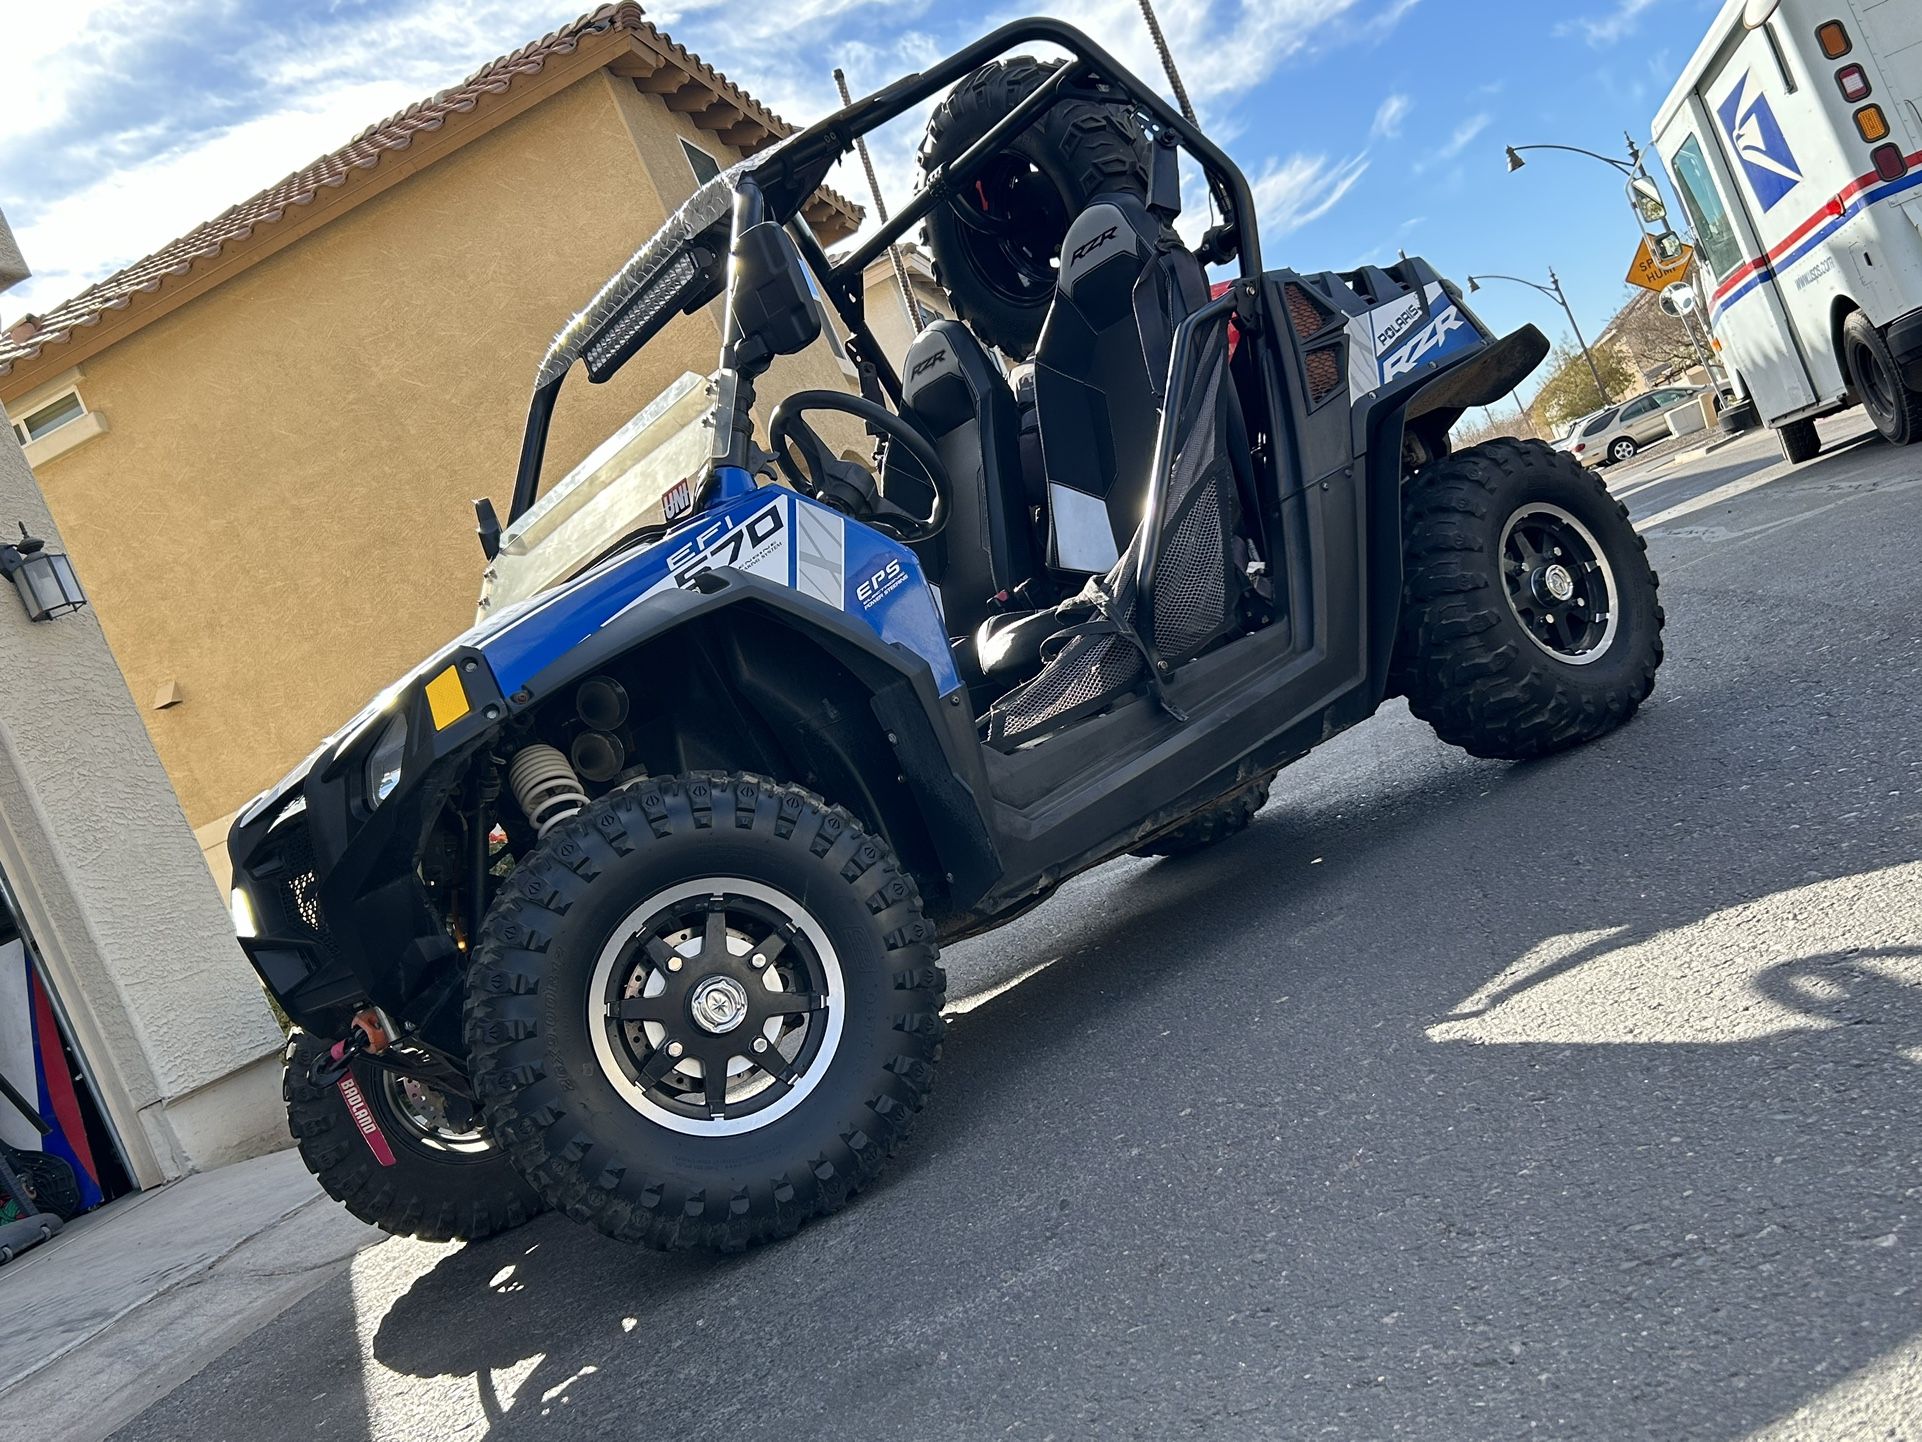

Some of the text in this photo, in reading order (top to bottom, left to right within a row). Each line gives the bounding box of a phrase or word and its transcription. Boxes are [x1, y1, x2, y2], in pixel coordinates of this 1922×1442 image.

[1071, 226, 1118, 267] RZR
[1377, 304, 1419, 346] POLARIS
[1383, 304, 1464, 385] RZR
[910, 350, 946, 382] RZR
[666, 515, 733, 571] EFI
[673, 505, 785, 595] 570
[856, 558, 900, 601] EPS
[864, 593, 884, 610] POWER
[340, 1078, 377, 1135] BADLAND
